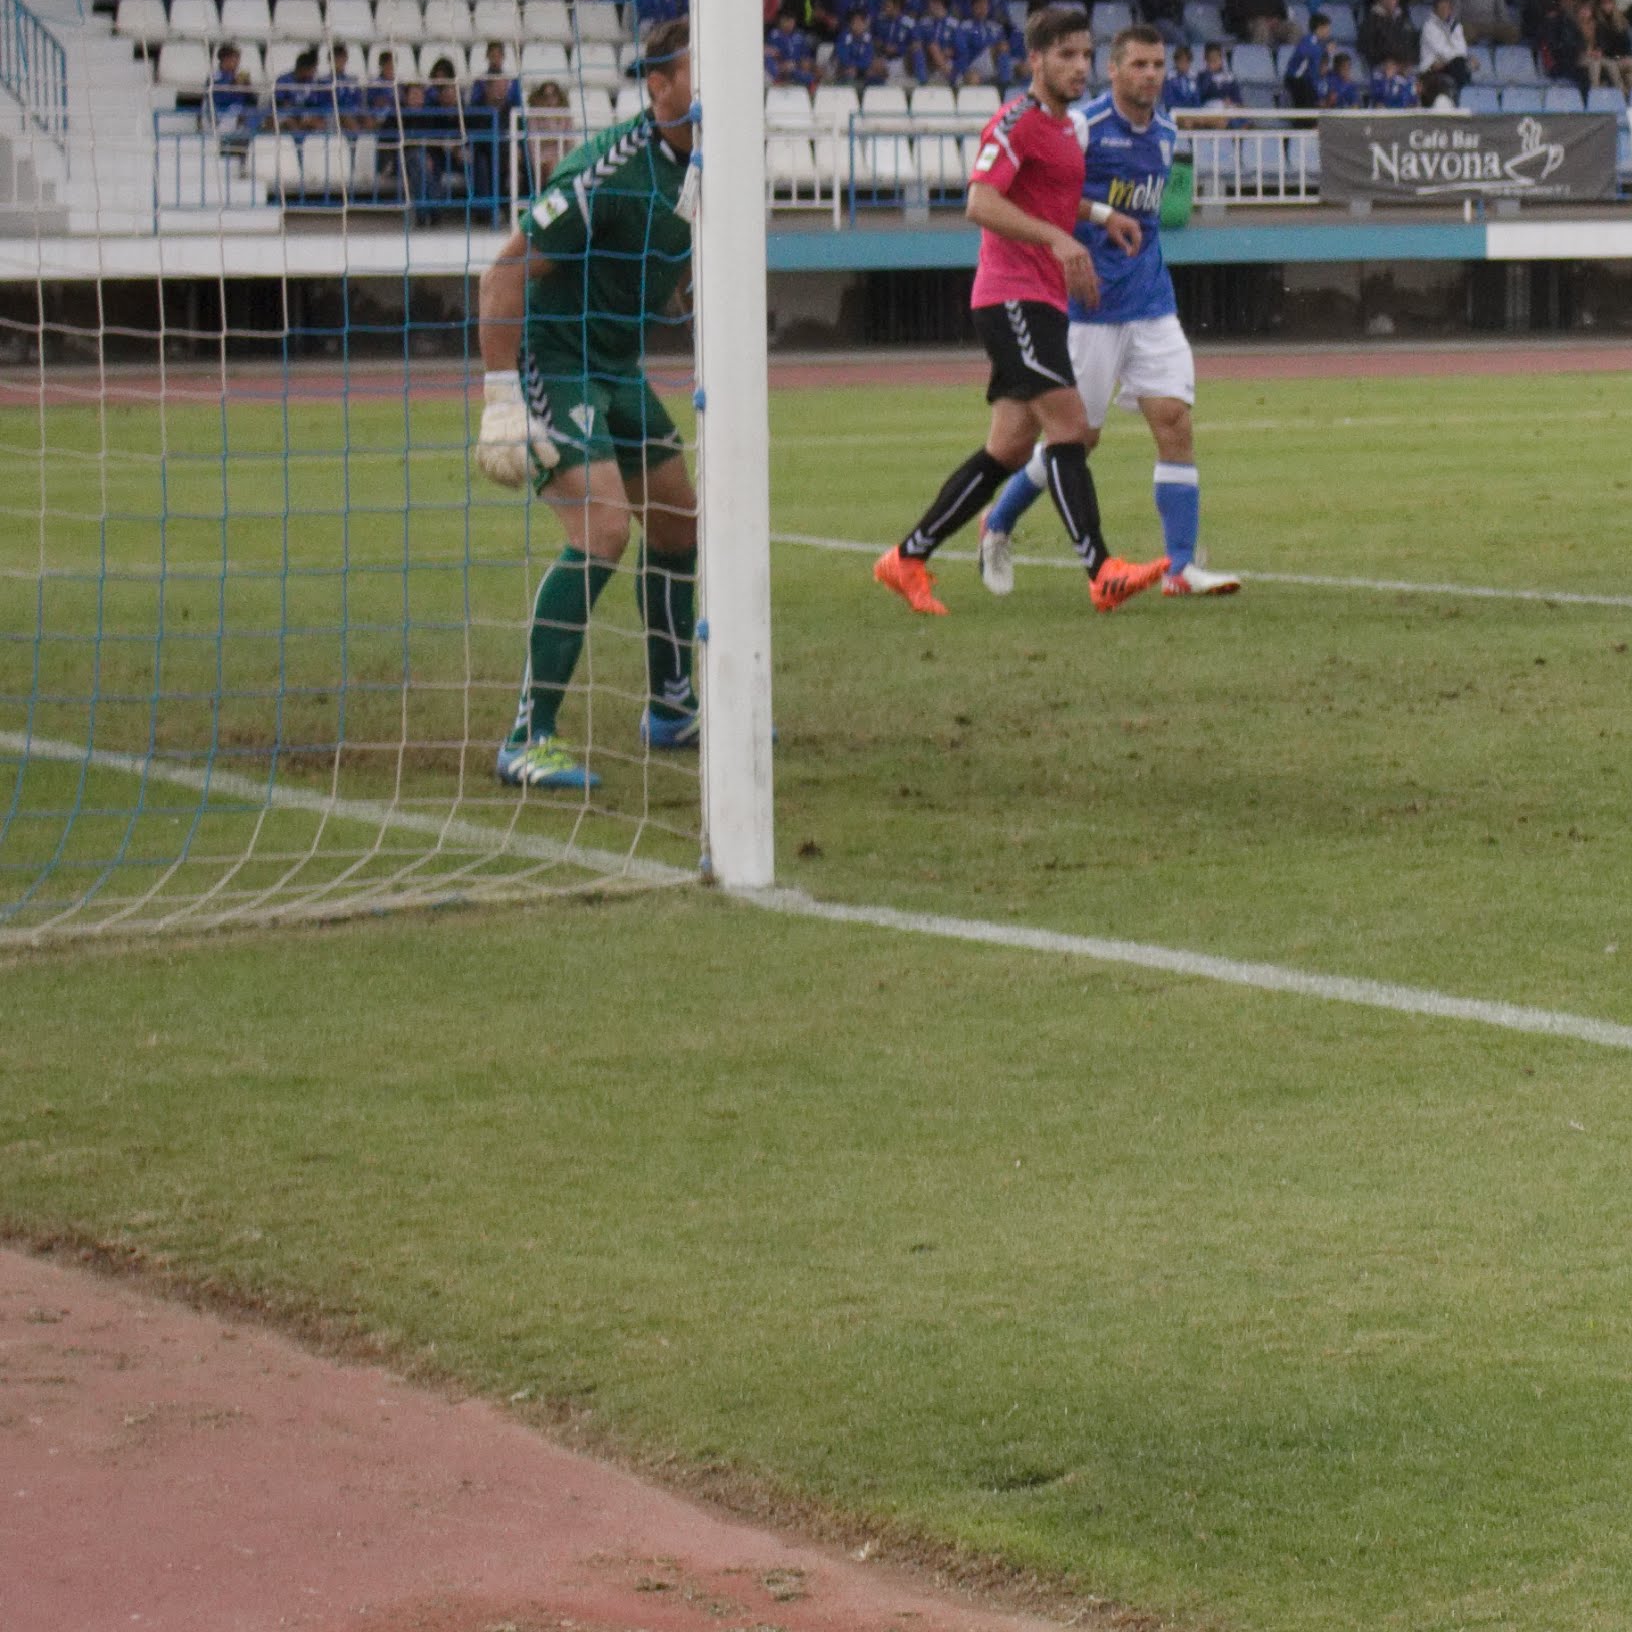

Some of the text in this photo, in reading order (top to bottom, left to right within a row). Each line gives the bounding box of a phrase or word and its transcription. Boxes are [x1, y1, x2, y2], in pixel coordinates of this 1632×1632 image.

[1408, 128, 1481, 150] Café Bar
[1369, 141, 1501, 185] Navona
